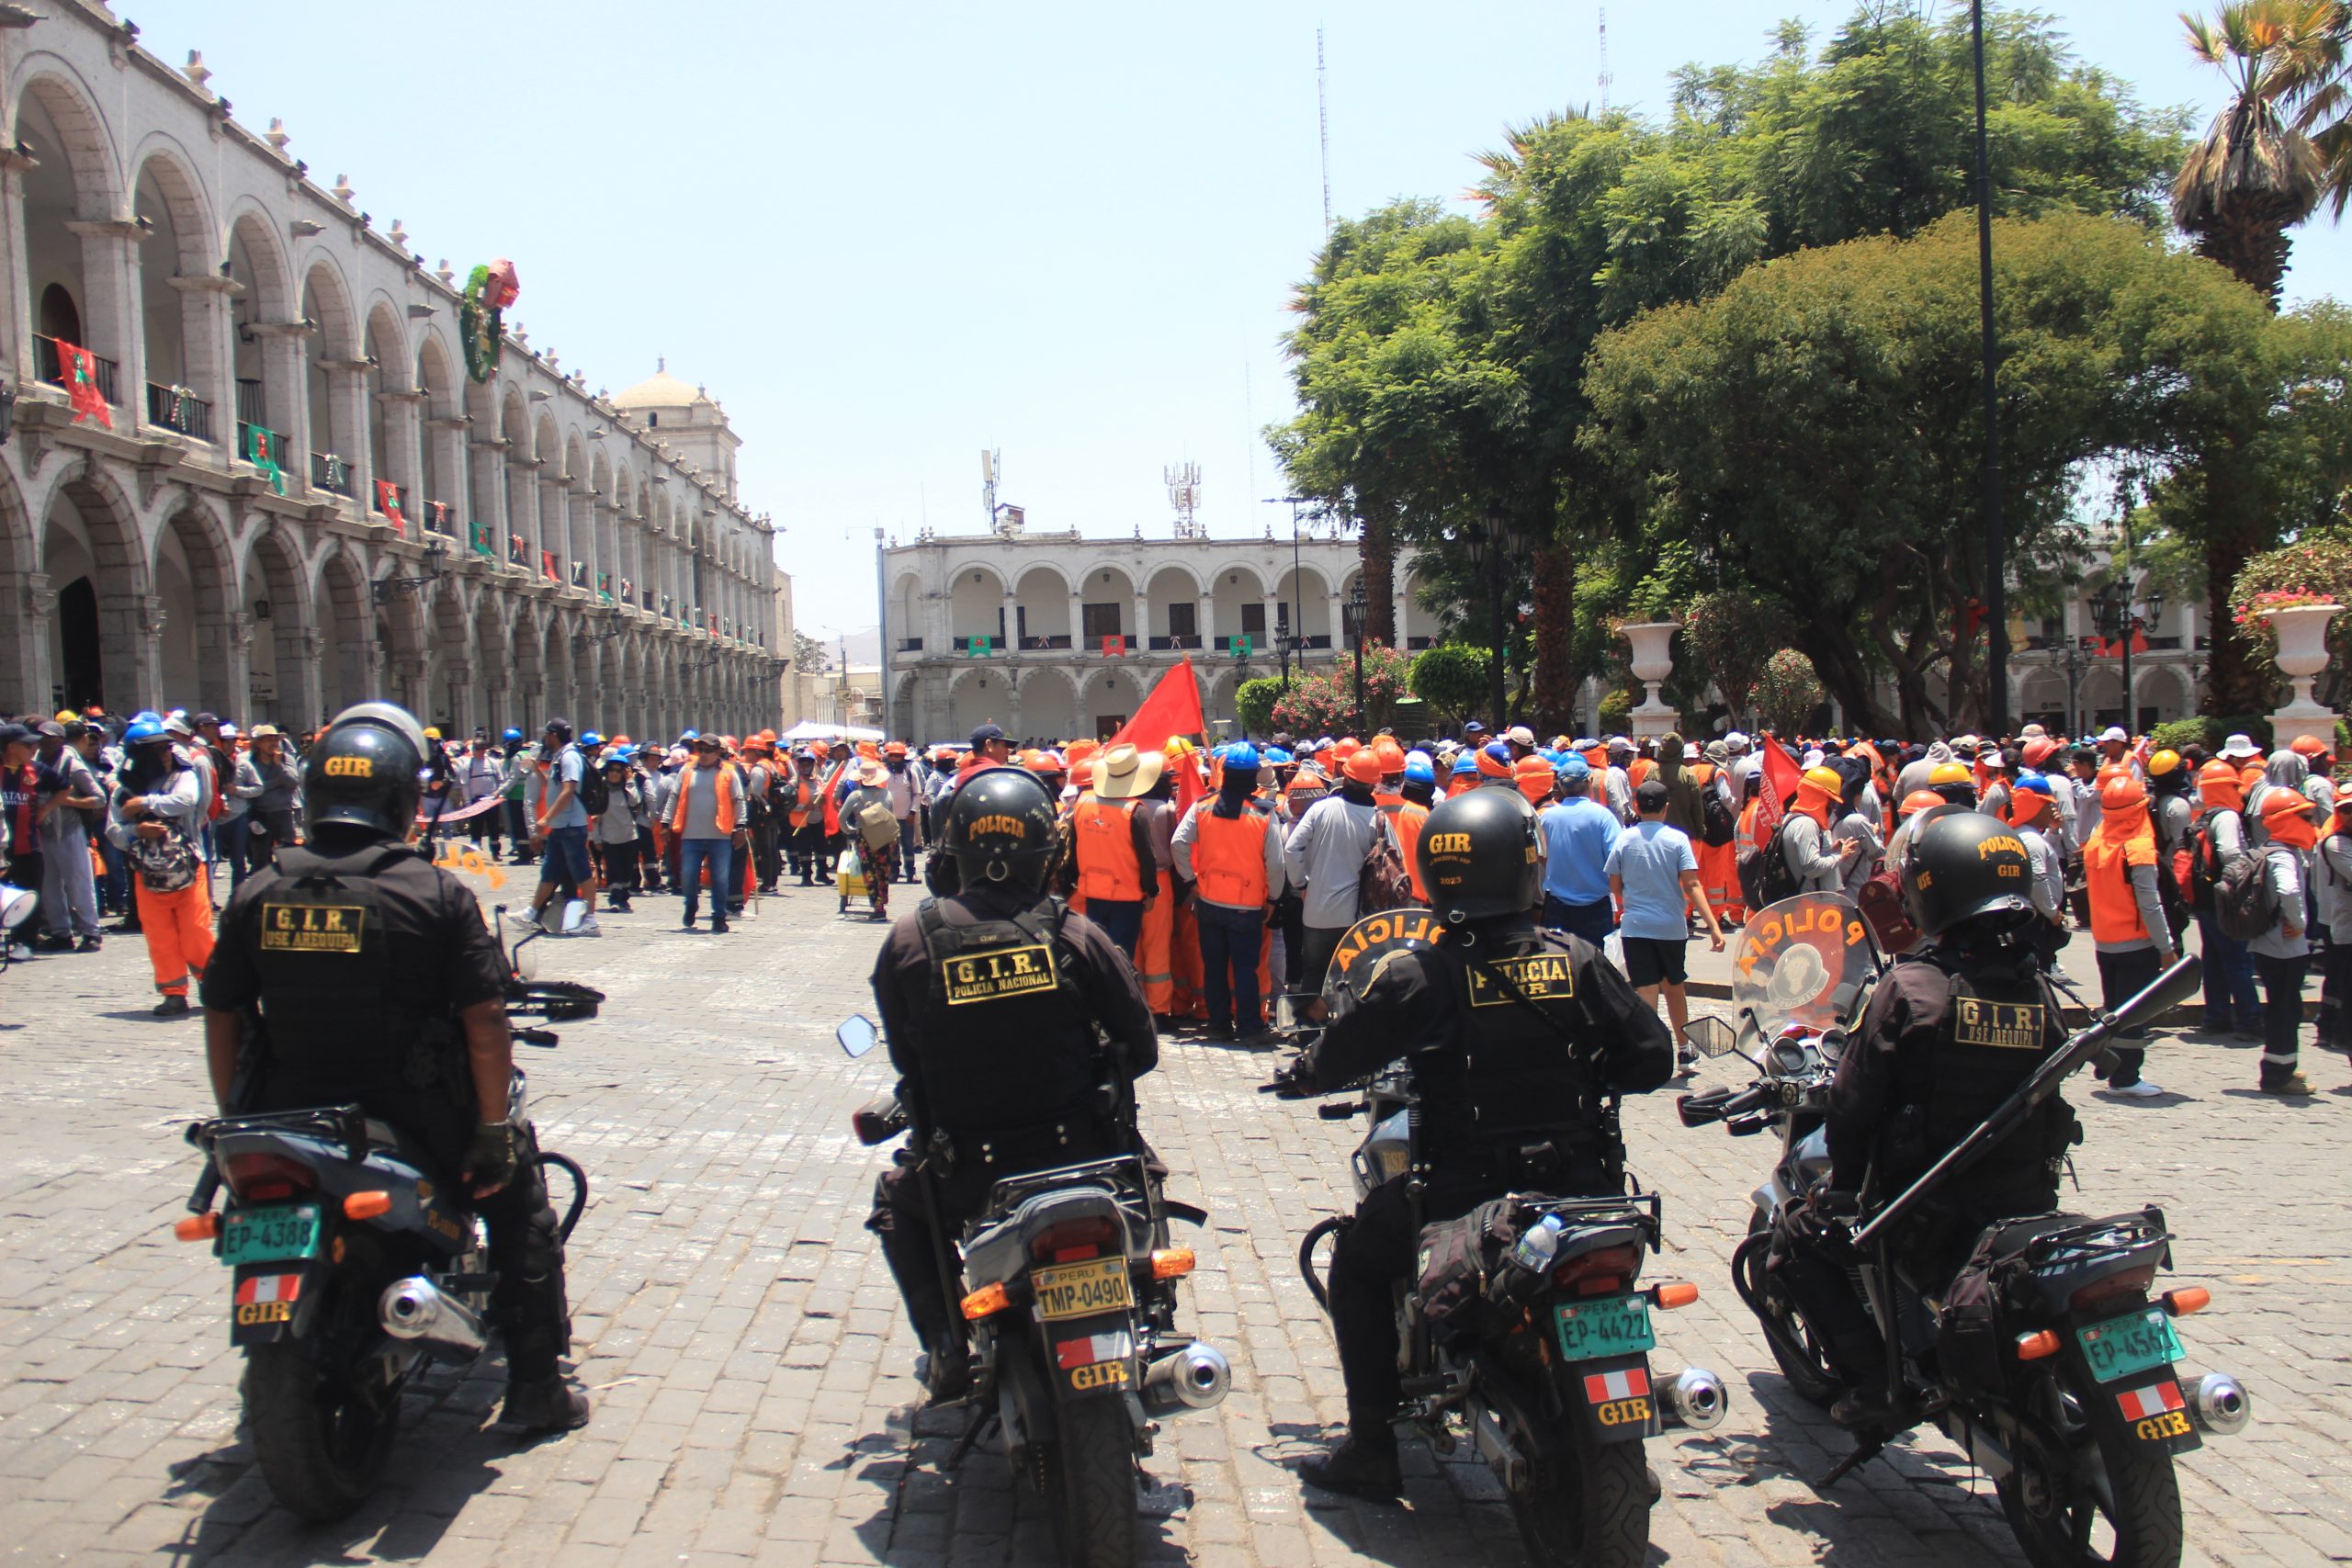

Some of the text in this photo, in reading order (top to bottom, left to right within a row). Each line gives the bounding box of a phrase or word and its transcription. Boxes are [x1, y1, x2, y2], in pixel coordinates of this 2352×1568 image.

[325, 756, 372, 777] GIR
[969, 815, 1024, 841] POLICIA
[1430, 832, 1472, 854] GIR
[1917, 870, 1932, 891] USE
[1997, 865, 2020, 877] GIR
[266, 931, 356, 948] USE AREQUIPA
[954, 973, 1049, 998] POLICIA NACIONAL
[1474, 961, 1566, 989] PLICIA
[1969, 1025, 2033, 1046] USE AREQUIPA
[227, 1221, 311, 1254] EP-4388
[1059, 1268, 1095, 1281] PERU
[1039, 1277, 1124, 1313] TMP-0490
[238, 1300, 291, 1325] GIR
[1563, 1313, 1648, 1348] EP-4422
[1071, 1360, 1128, 1390] GIR
[1598, 1398, 1652, 1426] GIR
[2136, 1411, 2191, 1440] GIR
